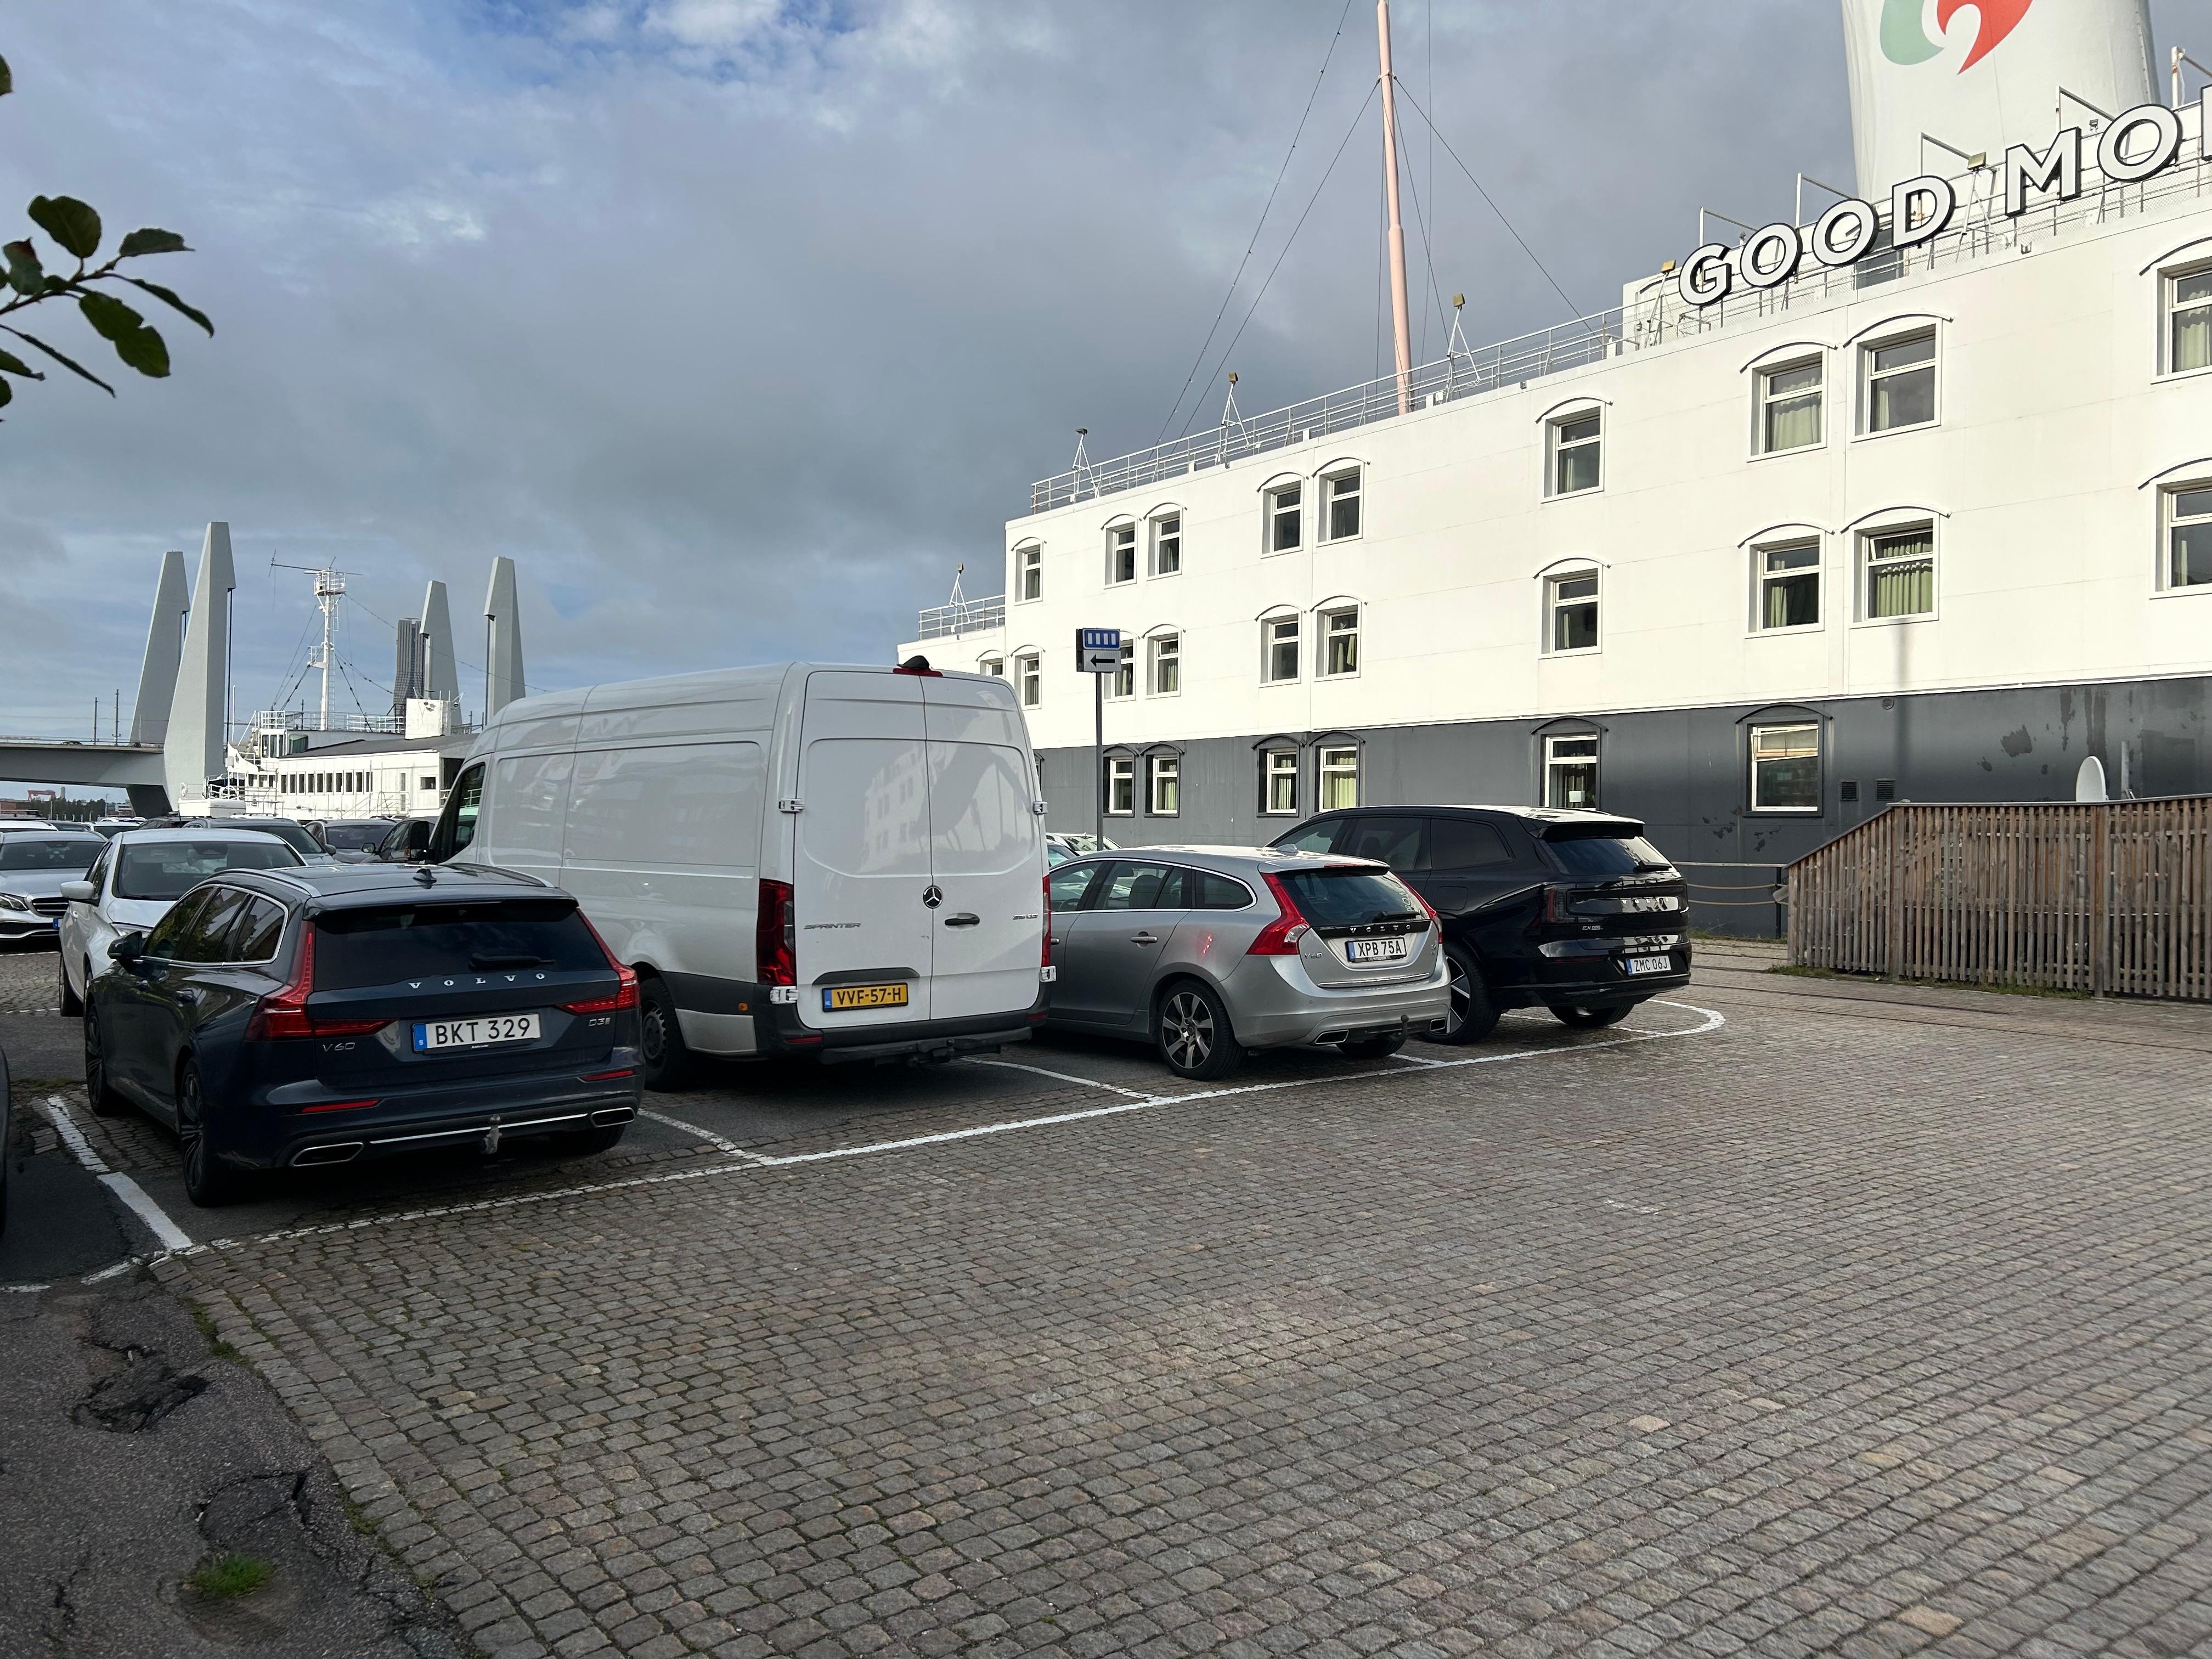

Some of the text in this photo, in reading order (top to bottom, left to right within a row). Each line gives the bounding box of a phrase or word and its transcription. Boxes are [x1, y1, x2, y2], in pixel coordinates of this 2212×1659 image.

[1679, 83, 2212, 306] GOOD MO
[1350, 924, 1411, 933] VOLVO
[1357, 940, 1402, 957] XPB 75A
[1634, 957, 1668, 972] ZMC 06J
[408, 973, 545, 989] VOLVO
[837, 987, 901, 1005] VVF-57-H
[435, 1017, 531, 1045] BKT 329
[322, 1042, 356, 1052] V60
